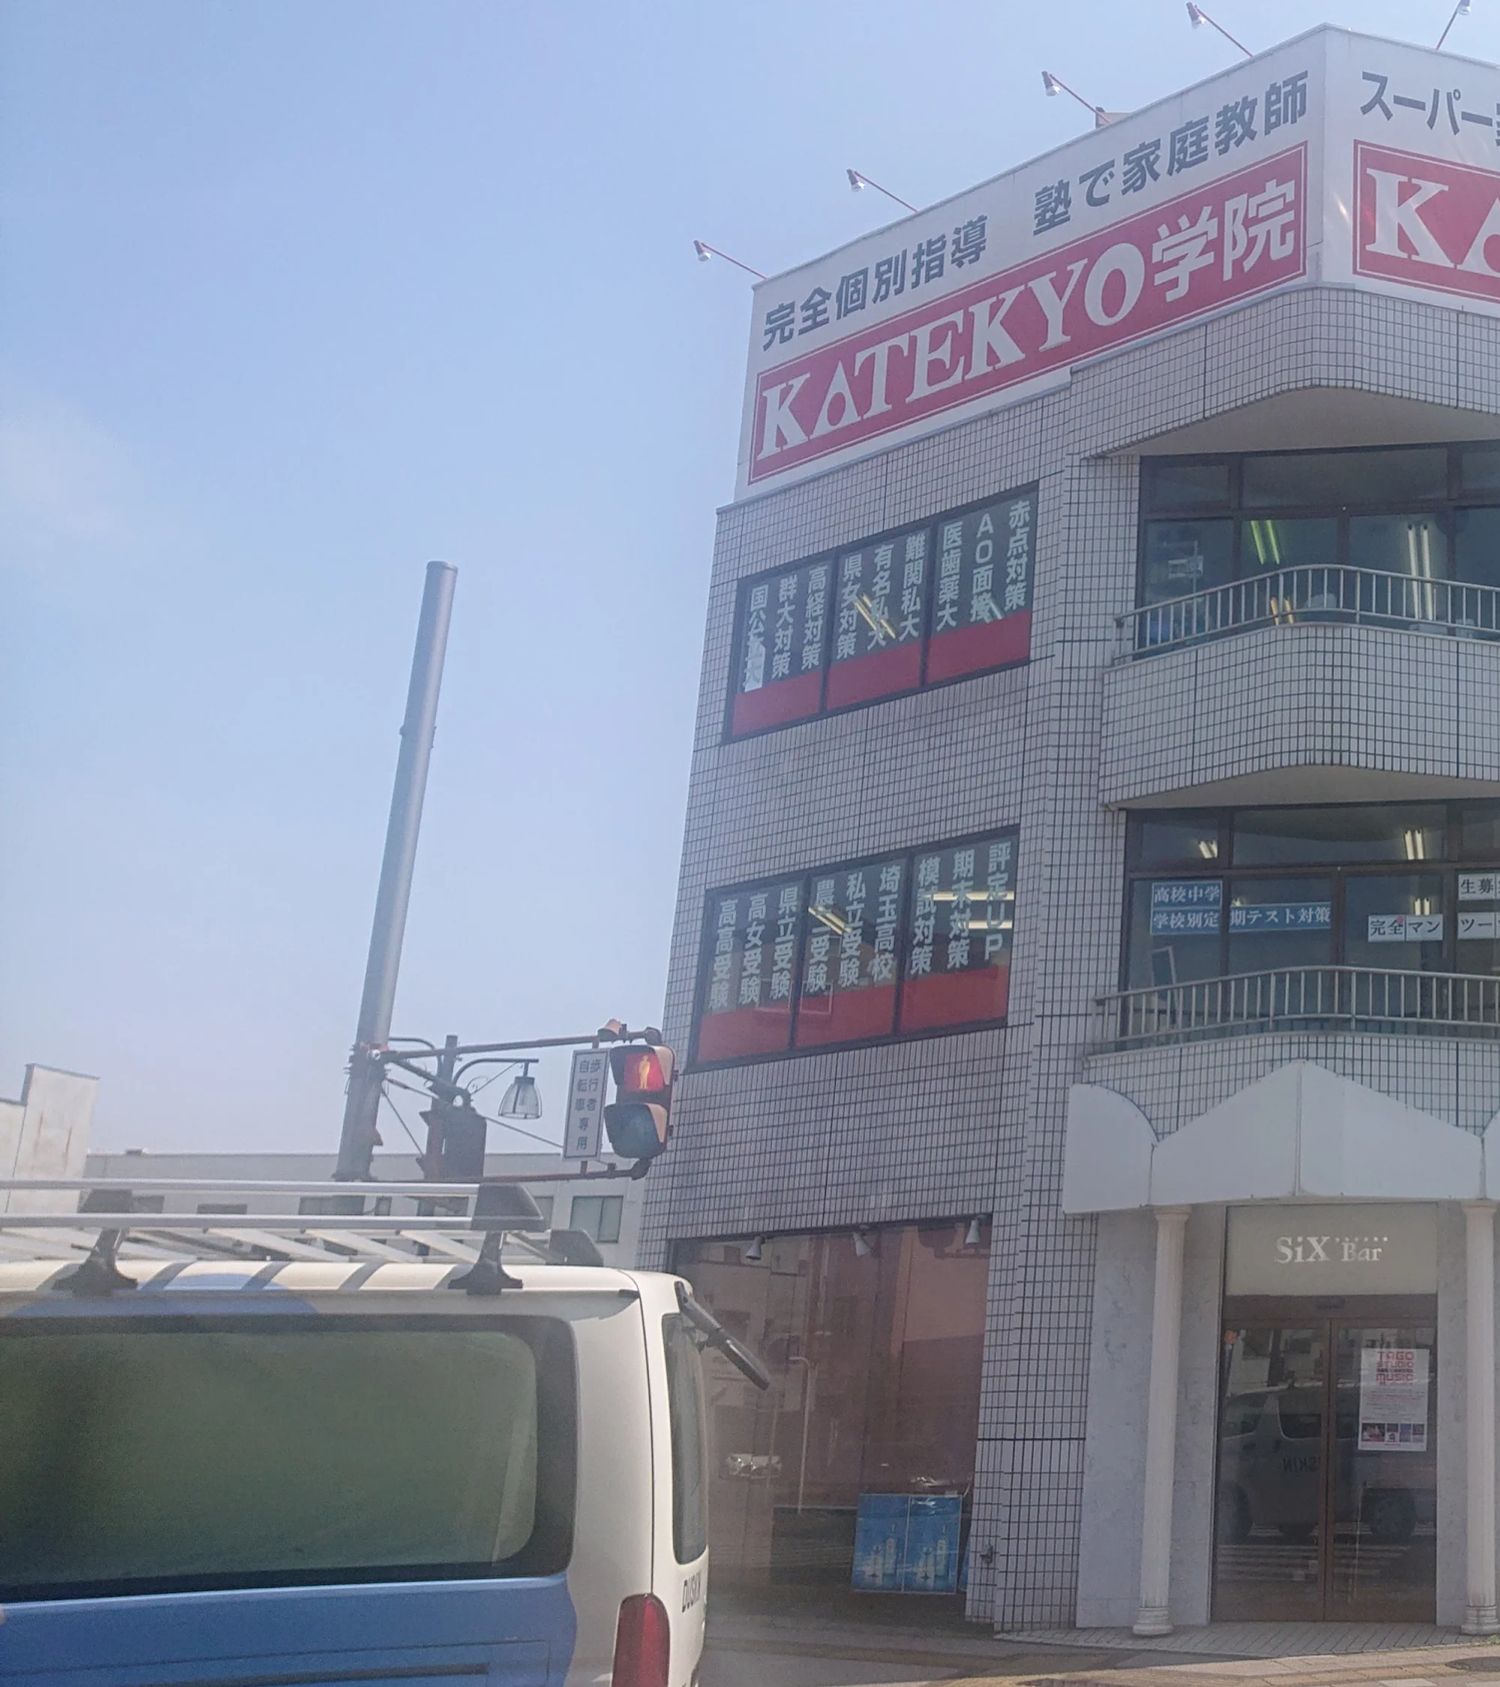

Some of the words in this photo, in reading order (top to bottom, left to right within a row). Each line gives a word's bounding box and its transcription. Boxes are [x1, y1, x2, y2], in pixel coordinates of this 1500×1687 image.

[761, 214, 988, 351] 完全個別指導
[1033, 69, 1308, 237] 塾で家庭教師
[756, 177, 1296, 462] KATEKYO学院
[836, 553, 863, 661] 県女対策
[867, 543, 894, 651] 有名私大
[898, 532, 926, 642] 難関私大
[936, 520, 963, 632] 医歯薬大
[970, 512, 999, 624] AO面接
[1003, 500, 1031, 612] 赤点対策
[771, 574, 798, 680] 群大対策
[801, 564, 828, 671] 高経対策
[738, 892, 769, 1005] 高女受験
[769, 885, 798, 1000] 県立受験
[838, 871, 867, 988] 私立受験
[871, 865, 901, 983] 埼玉高校
[910, 856, 941, 976] 模試対策
[946, 849, 975, 969] 期末対策
[984, 841, 1012, 961] 評定UP
[1153, 883, 1222, 905] 高校中学
[1153, 911, 1220, 930] 学校別定
[1230, 905, 1331, 927] 期テスト対策
[1369, 917, 1442, 938] 完全マン
[708, 898, 738, 1009] 高高受験
[1340, 1241, 1382, 1262] Bar
[1377, 1351, 1415, 1361] TAGO
